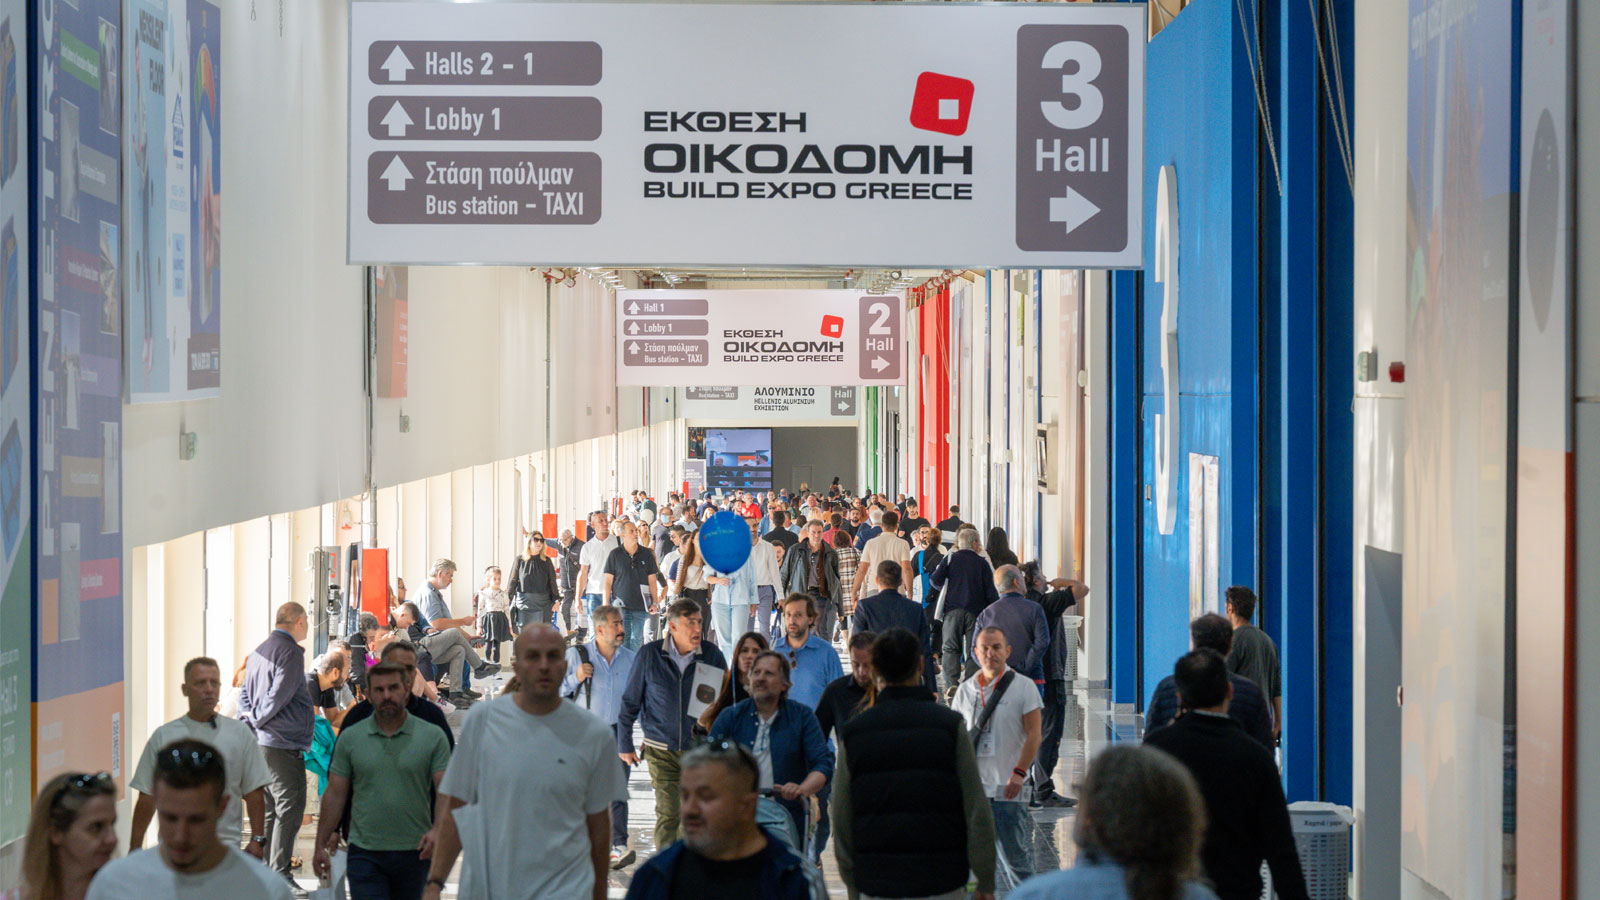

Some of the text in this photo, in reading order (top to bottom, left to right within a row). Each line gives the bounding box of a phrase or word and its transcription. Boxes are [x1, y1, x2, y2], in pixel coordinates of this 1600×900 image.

[425, 51, 474, 76] Halls
[480, 51, 494, 76] 2
[523, 52, 533, 76] 1
[1040, 40, 1104, 130] 3
[425, 106, 501, 137] Lobby 1
[644, 111, 807, 133] ΕΚΘΕΣΗ
[643, 143, 973, 175] ΟΙΚΟΔΟΜΗ
[1035, 137, 1110, 173] Hall
[425, 161, 574, 190] Στάση πούλμαν
[643, 181, 973, 200] BUILD EXPO GREECE
[426, 194, 457, 215] Bus
[462, 194, 519, 215] station
[542, 191, 584, 216] TAXI
[643, 302, 664, 313] Hall 1
[868, 302, 891, 335] 2
[643, 322, 673, 335] Lobby 1
[723, 329, 784, 339] ΕΚΘΕΣΗ
[644, 342, 699, 355] Στάση πούλμαν
[723, 341, 844, 353] ΟΙΚΟΔΟΜΗ
[865, 337, 894, 352] Hall
[644, 354, 657, 363] Bus
[657, 354, 679, 363] station
[687, 352, 703, 363] TAXI
[723, 354, 844, 362] BUILD EXPO GREECE
[754, 387, 815, 397] ΑΛΟΥΜΙΝΙΟ
[834, 390, 852, 399] Hall
